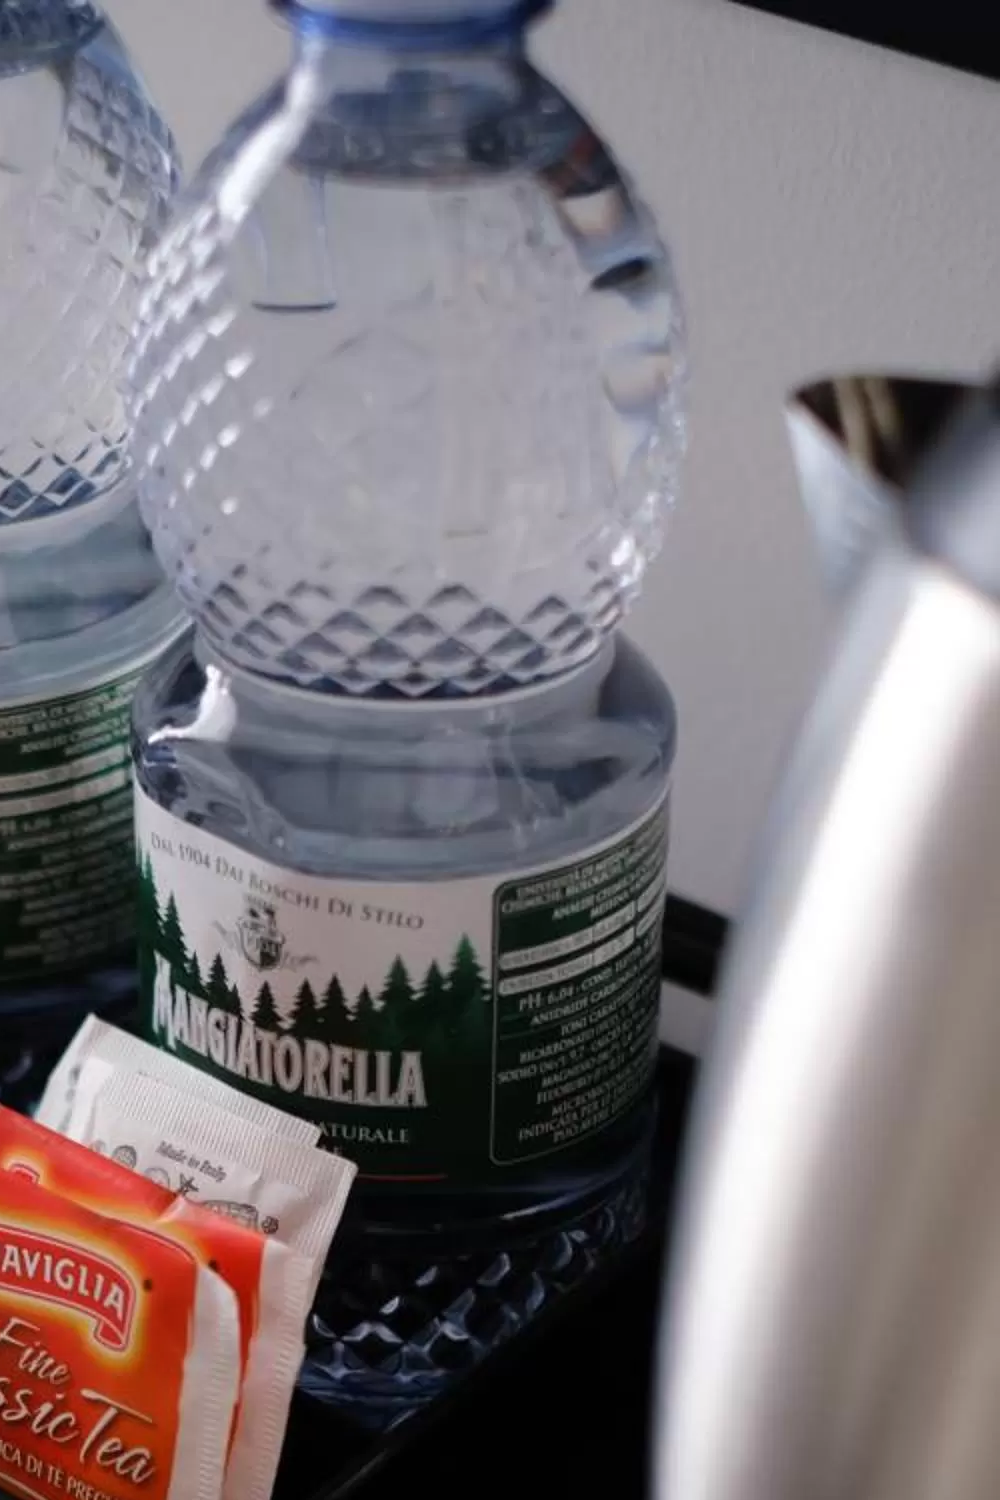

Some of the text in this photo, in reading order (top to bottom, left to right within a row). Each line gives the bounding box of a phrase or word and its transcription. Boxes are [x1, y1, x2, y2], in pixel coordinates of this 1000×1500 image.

[178, 843, 210, 869] 1904
[359, 904, 424, 930] STILO
[152, 948, 427, 1107] MANGIATORELLA
[155, 1139, 228, 1184] Made in Italy
[318, 1119, 410, 1145] ATURALE
[25, 1454, 44, 1479] DI
[79, 1387, 154, 1485] Tea
